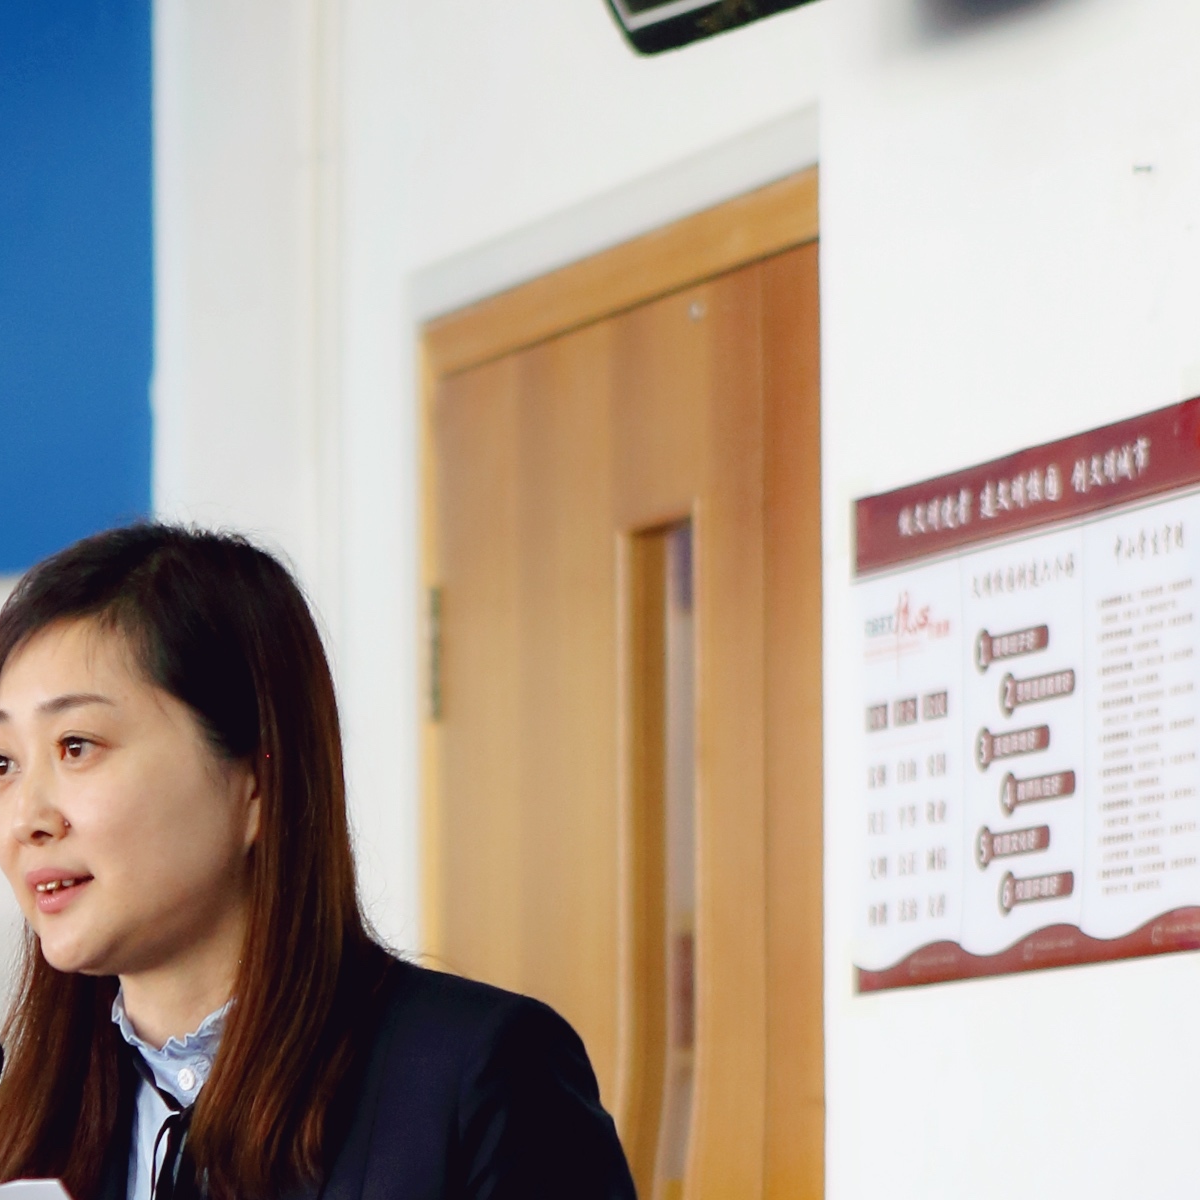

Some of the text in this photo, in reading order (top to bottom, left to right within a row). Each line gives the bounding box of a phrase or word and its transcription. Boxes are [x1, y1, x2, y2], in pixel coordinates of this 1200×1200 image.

[1072, 437, 1150, 493] 创文明城市
